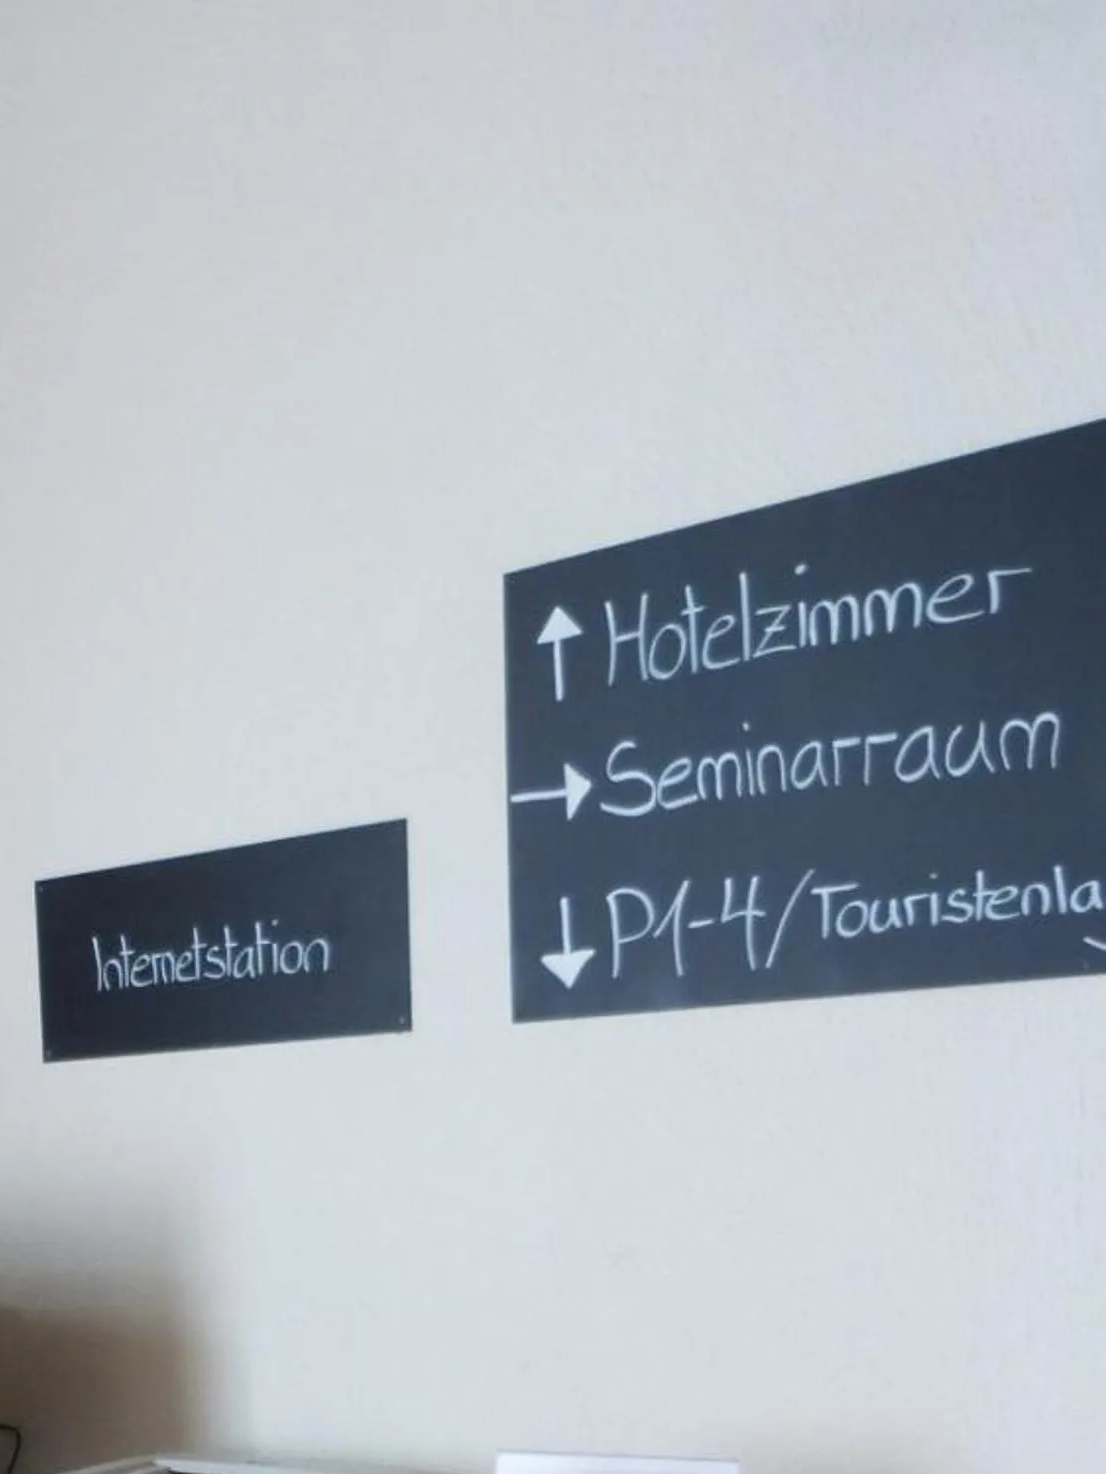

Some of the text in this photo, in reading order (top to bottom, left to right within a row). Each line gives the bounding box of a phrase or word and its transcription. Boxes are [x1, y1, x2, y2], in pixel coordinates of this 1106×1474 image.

[605, 563, 1032, 687] Hotelzimmer
[600, 711, 1060, 816] Seminarraum
[91, 918, 331, 992] Internetstation
[606, 864, 1106, 979] P1-4/Touristenla
